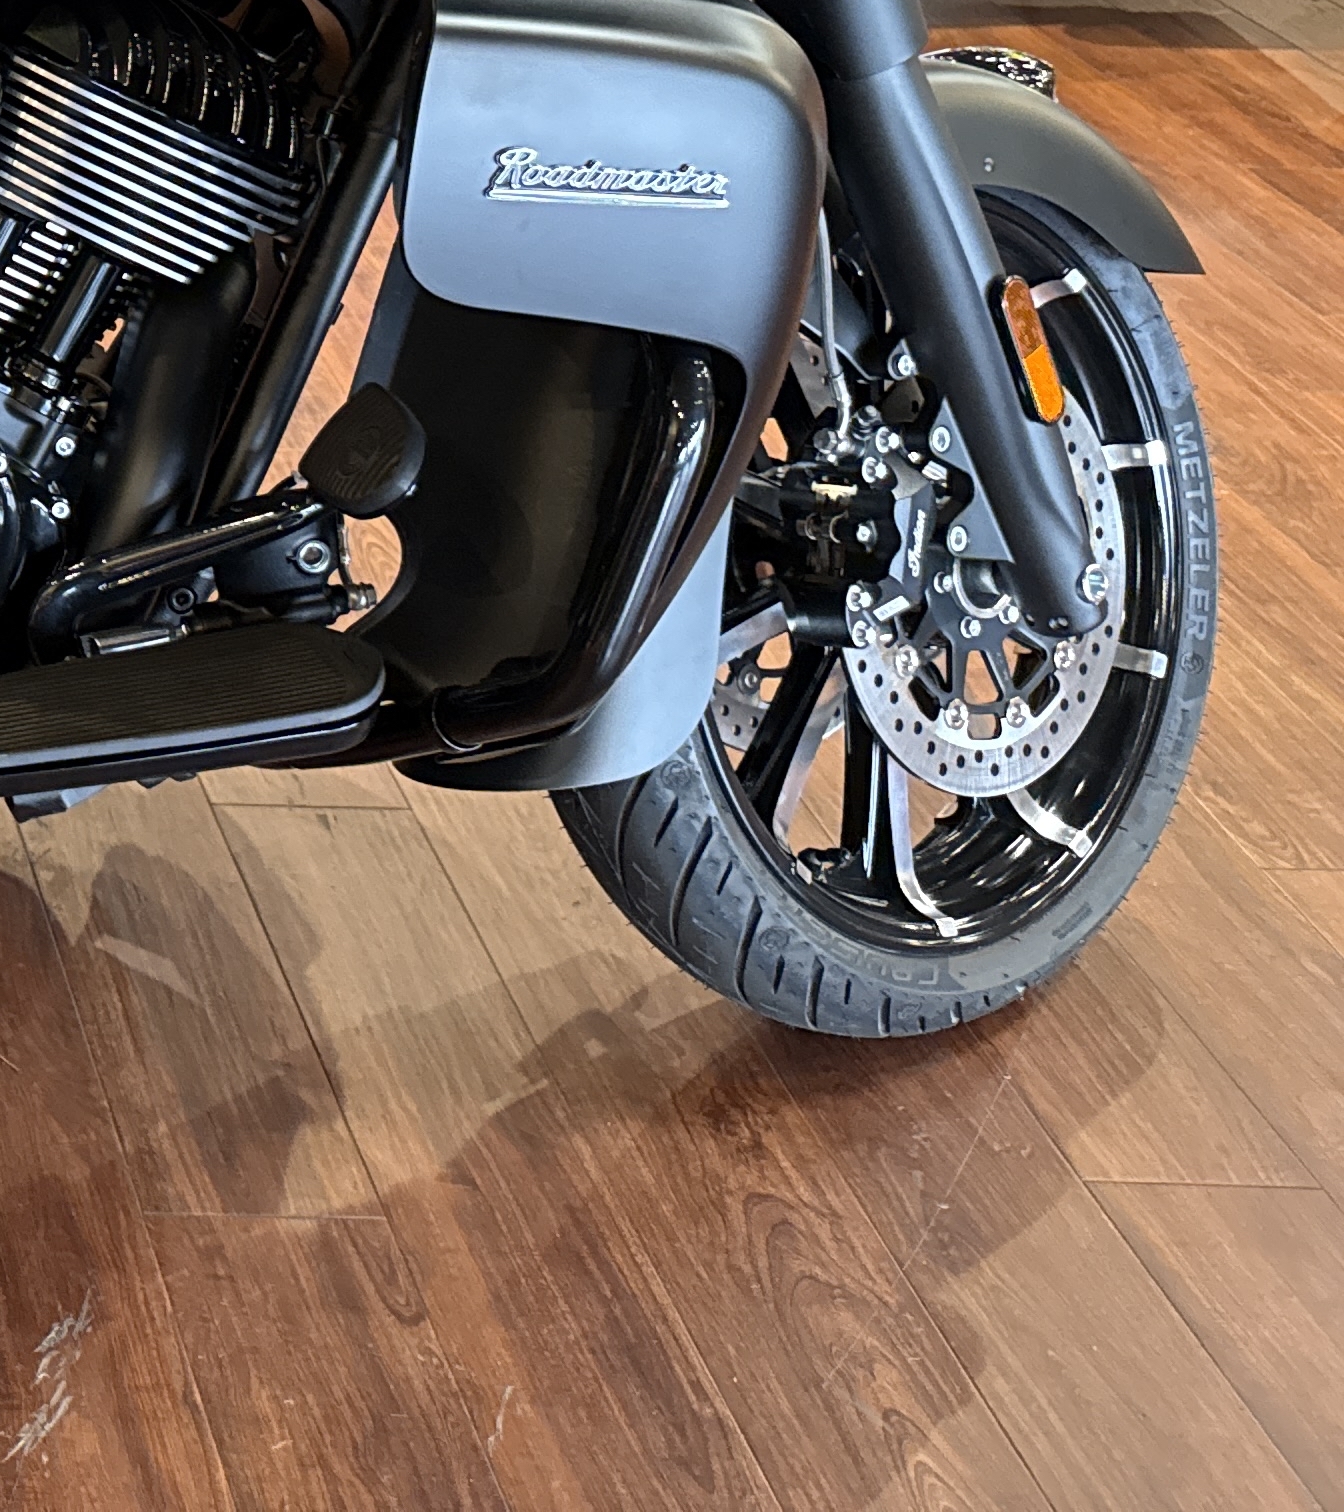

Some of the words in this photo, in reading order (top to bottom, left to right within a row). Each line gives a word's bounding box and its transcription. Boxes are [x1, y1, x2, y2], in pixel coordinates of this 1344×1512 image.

[493, 146, 730, 197] Roadmaster
[908, 509, 926, 577] Indian
[1173, 420, 1211, 642] METZELER
